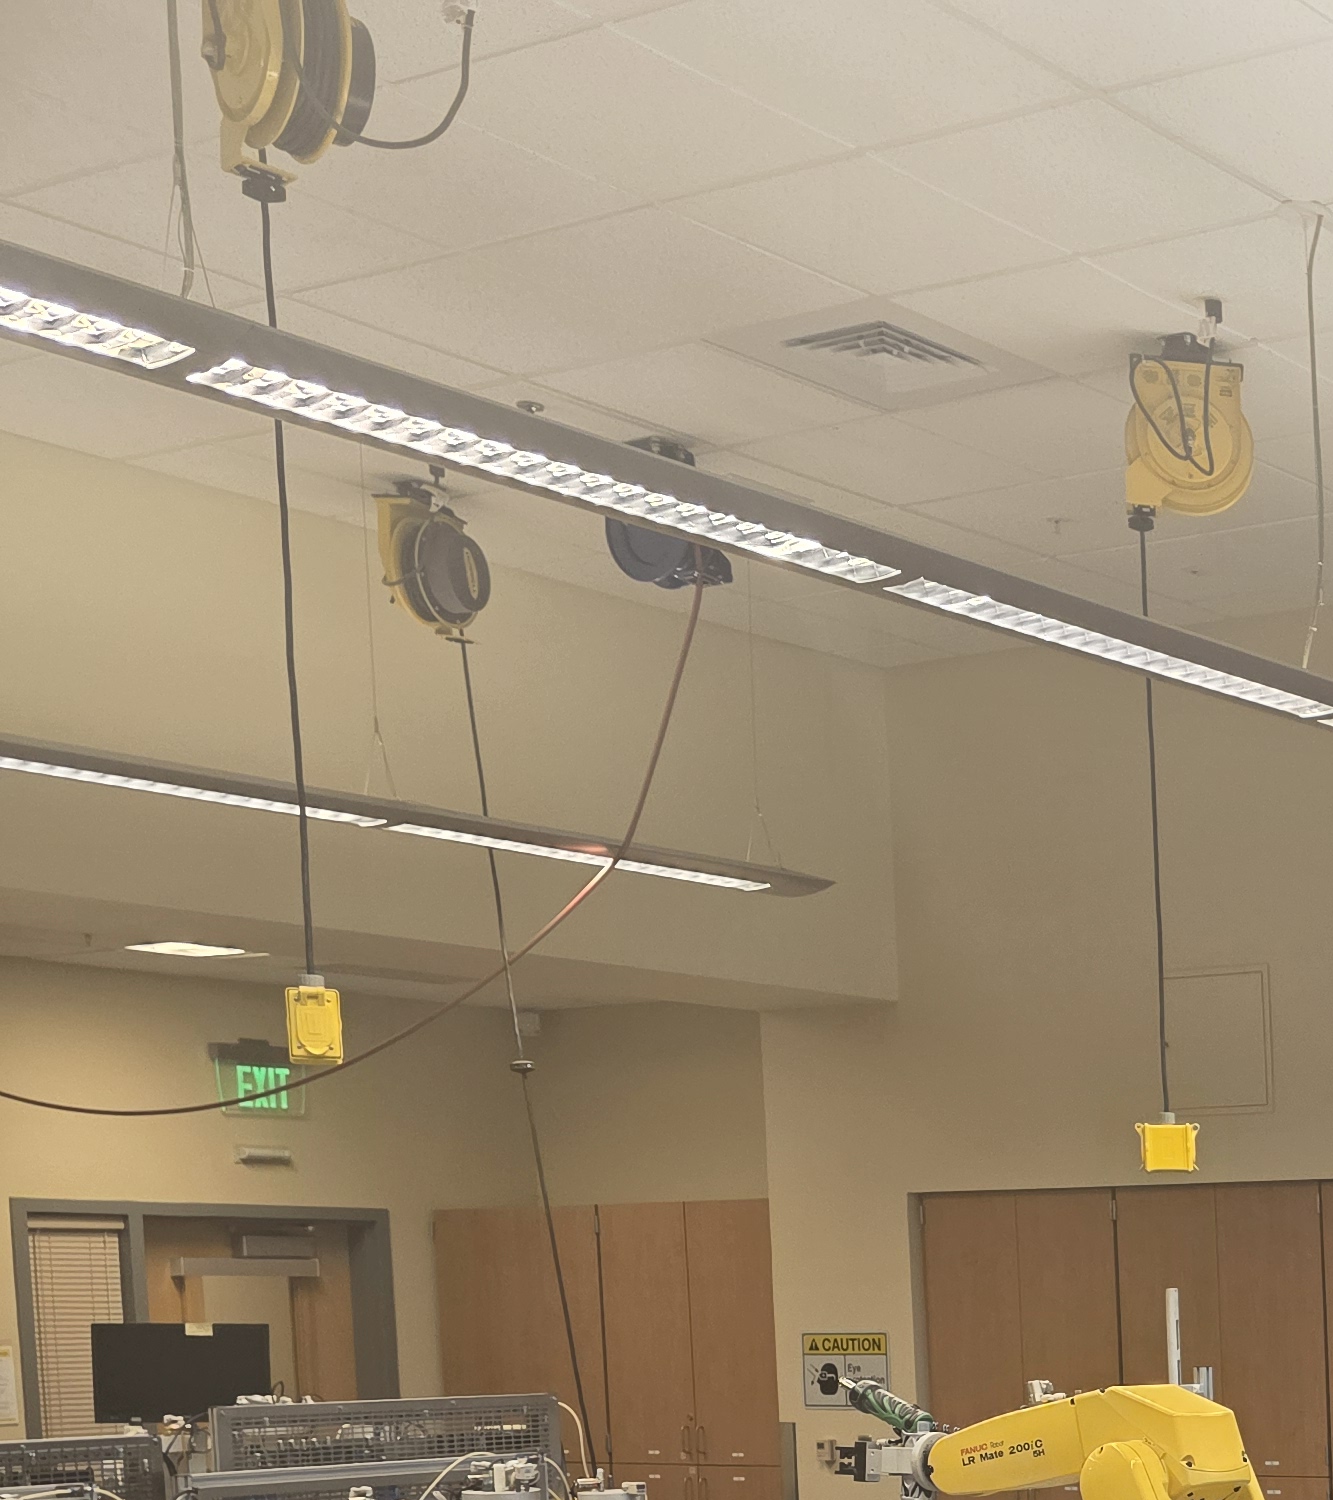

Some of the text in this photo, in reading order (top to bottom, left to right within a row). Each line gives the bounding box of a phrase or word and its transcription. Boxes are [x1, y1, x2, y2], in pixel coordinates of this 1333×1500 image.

[236, 1065, 290, 1109] EXIT
[822, 1337, 882, 1352] CAUTION
[847, 1363, 861, 1375] Eye
[960, 1443, 988, 1456] FANUC
[962, 1439, 1043, 1467] LR Mate 200iC
[1032, 1448, 1046, 1458] 5H
